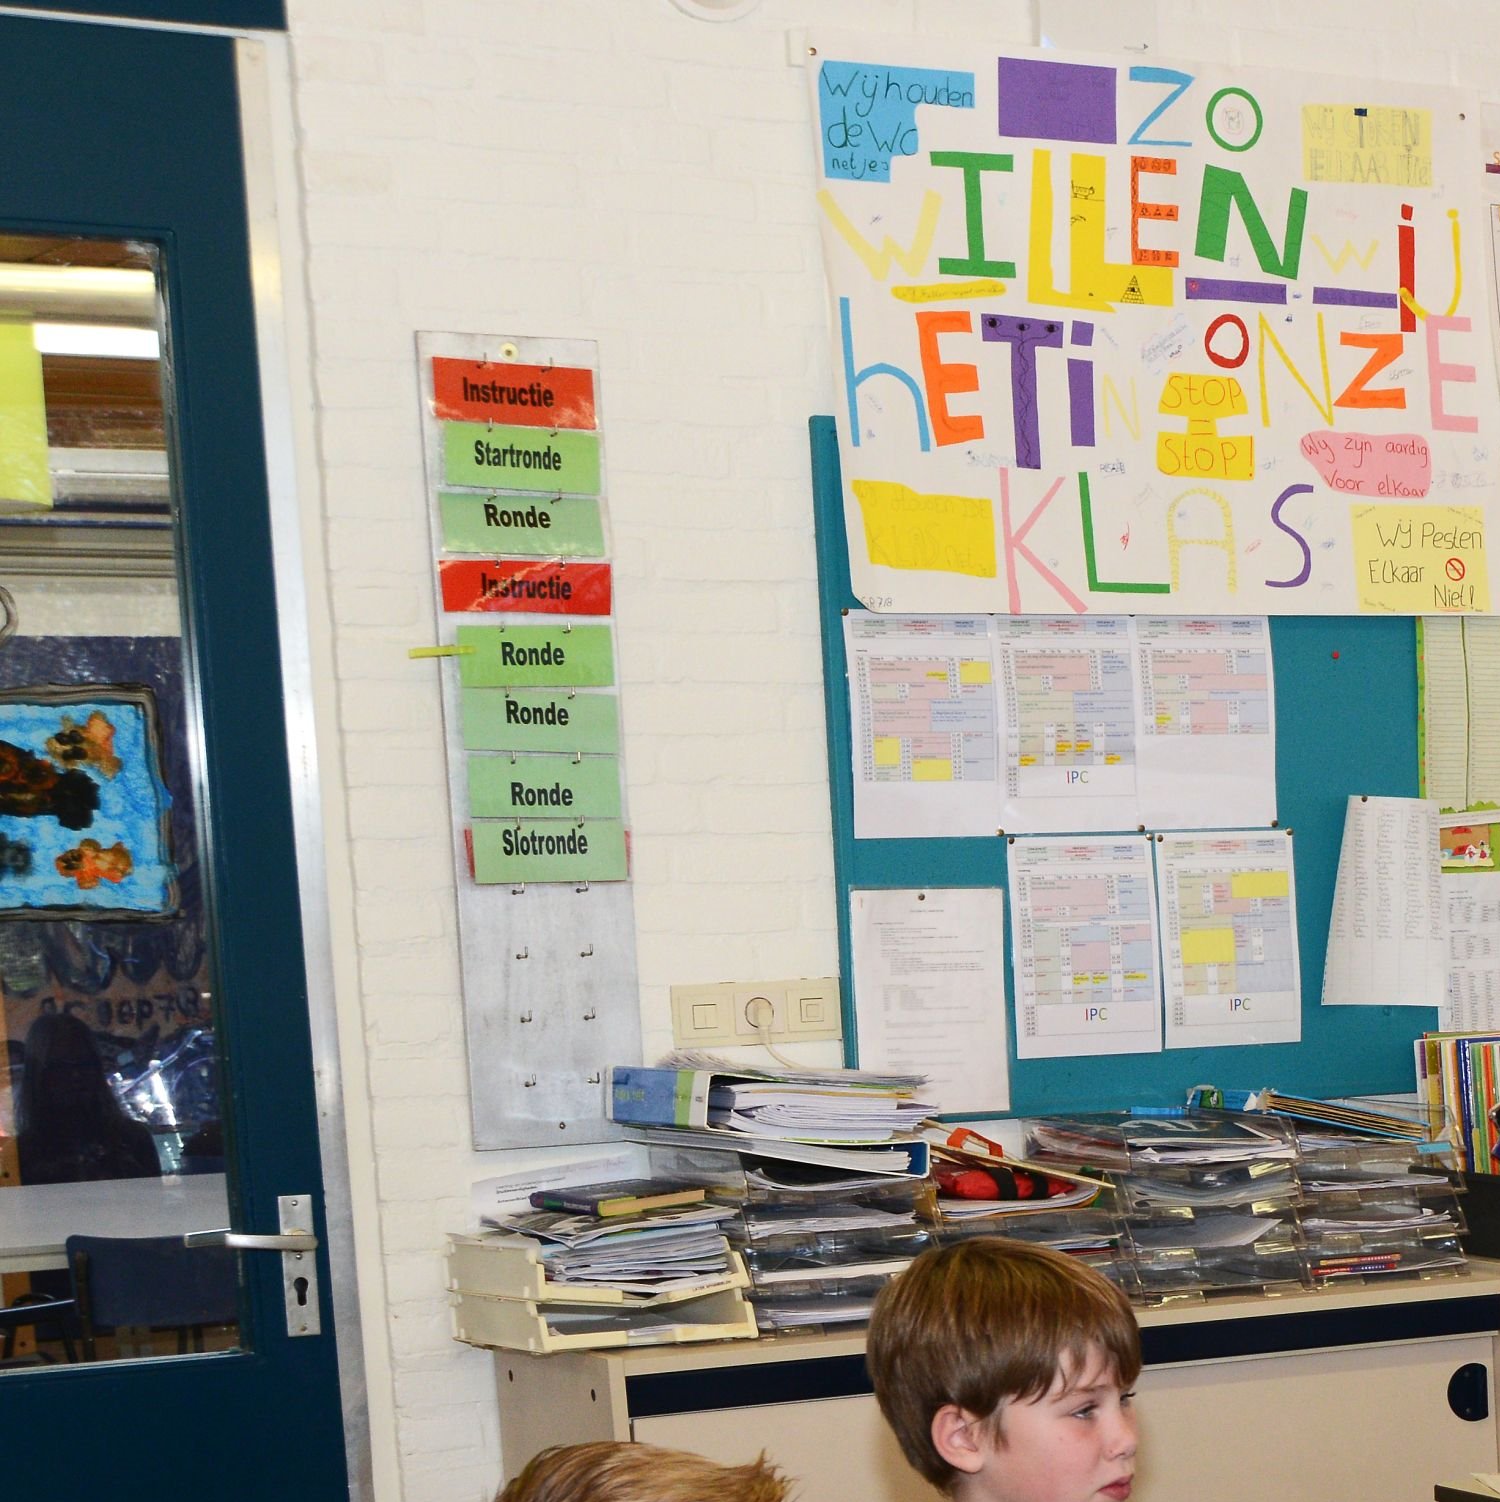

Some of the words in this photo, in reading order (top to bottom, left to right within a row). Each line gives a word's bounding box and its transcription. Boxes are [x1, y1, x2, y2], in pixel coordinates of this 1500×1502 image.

[885, 71, 974, 107] houden
[1128, 66, 1263, 152] ZO
[828, 106, 862, 148] de
[1204, 311, 1479, 433] ONZE
[463, 377, 554, 408] Instructie
[474, 440, 562, 472] Startronde
[1385, 440, 1428, 468] aardig
[483, 503, 551, 529] Ronde
[999, 468, 1315, 614] KLAS
[1421, 522, 1483, 550] Pesten
[481, 573, 572, 600] Instructie
[501, 642, 565, 666] Ronde
[505, 700, 569, 726] Ronde
[1067, 771, 1089, 785] IPC
[511, 782, 573, 806] Ronde
[502, 829, 588, 857] Slotronde
[1085, 1007, 1108, 1022] IPC
[1230, 998, 1251, 1012] IPC
